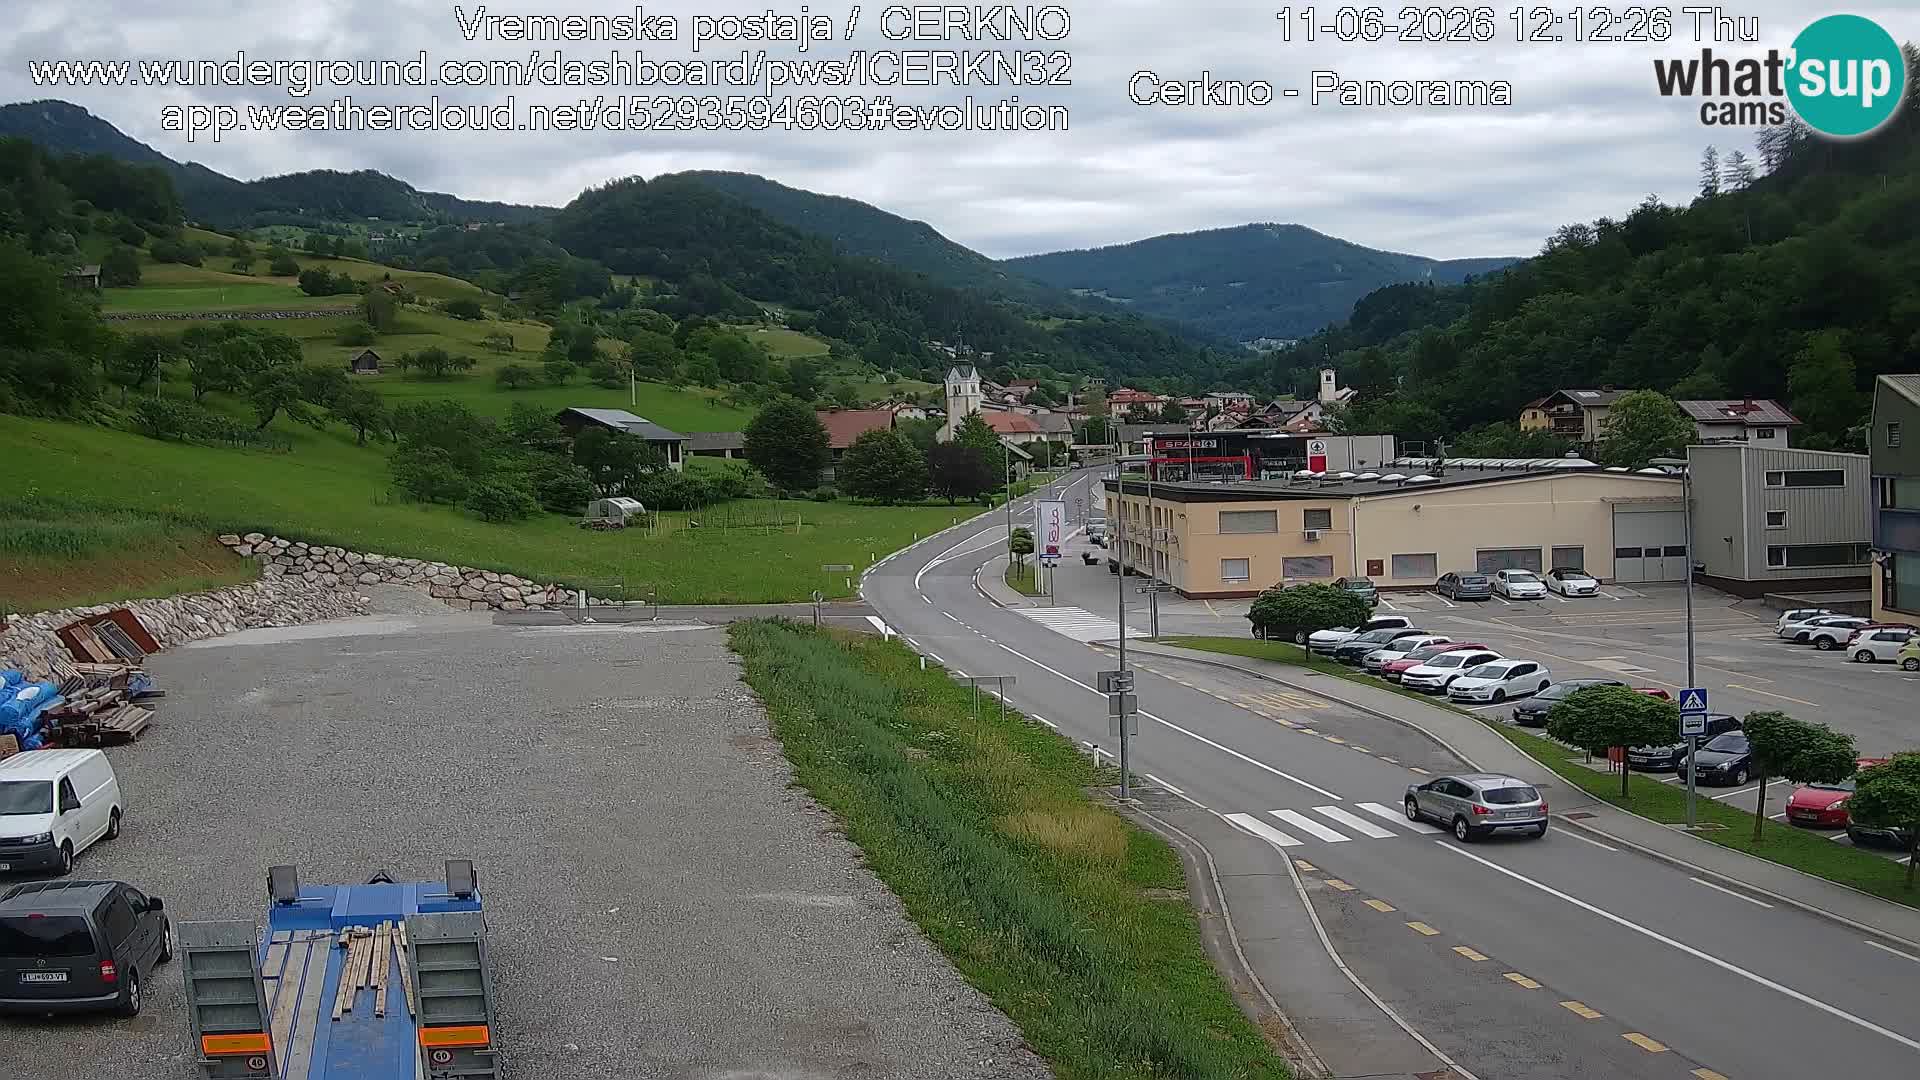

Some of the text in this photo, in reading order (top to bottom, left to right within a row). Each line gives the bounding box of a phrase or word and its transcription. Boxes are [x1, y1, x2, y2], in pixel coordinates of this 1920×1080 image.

[1165, 440, 1201, 448] SPAR
[435, 1052, 448, 1060] 60
[251, 1059, 263, 1067] 40
